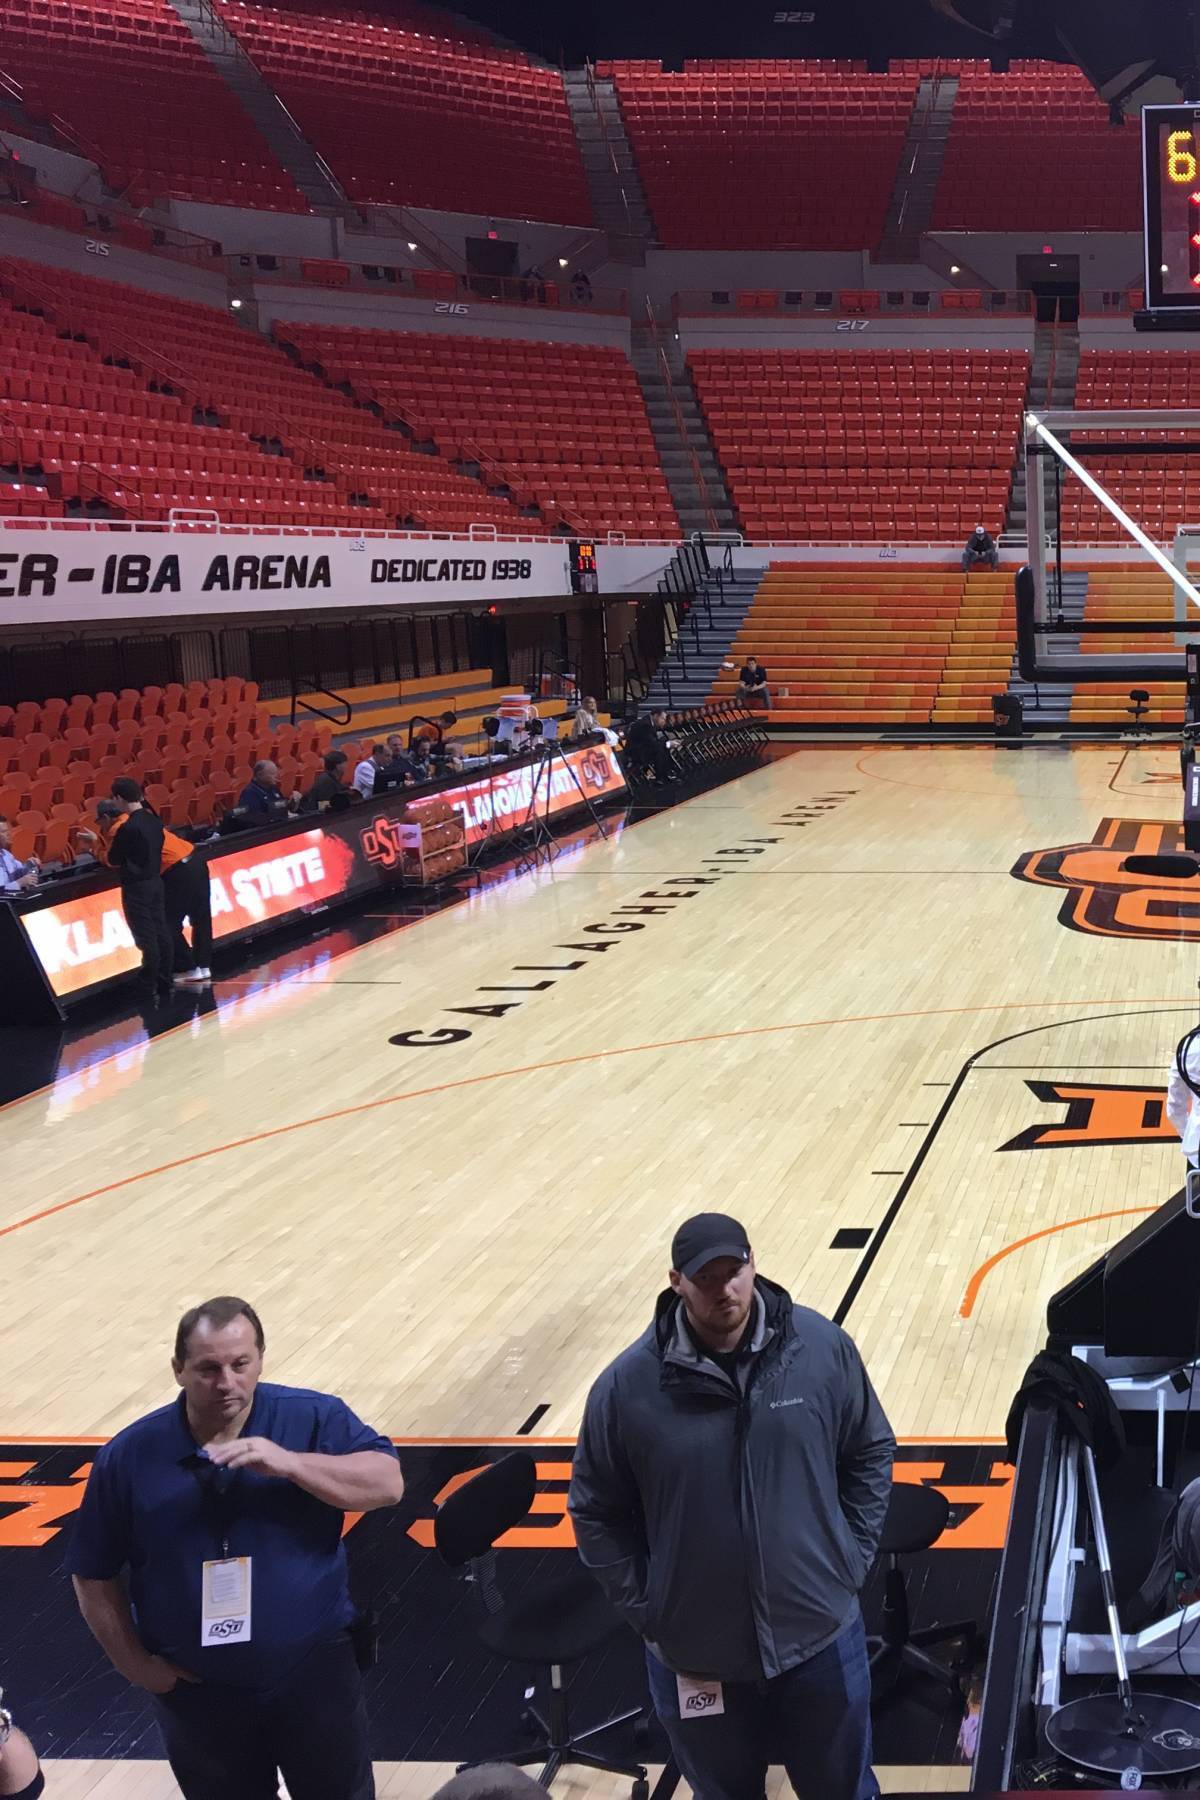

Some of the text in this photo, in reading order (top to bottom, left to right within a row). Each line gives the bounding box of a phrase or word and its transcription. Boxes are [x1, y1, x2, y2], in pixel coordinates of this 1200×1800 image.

[435, 302, 470, 314] 216
[837, 320, 869, 330] 217
[201, 555, 331, 591] ARENA
[371, 559, 486, 583] DEDICATED
[491, 559, 532, 580] 1938
[768, 790, 862, 827] ARENA
[208, 1619, 244, 1638] OSU
[686, 1692, 717, 1710] OSU
